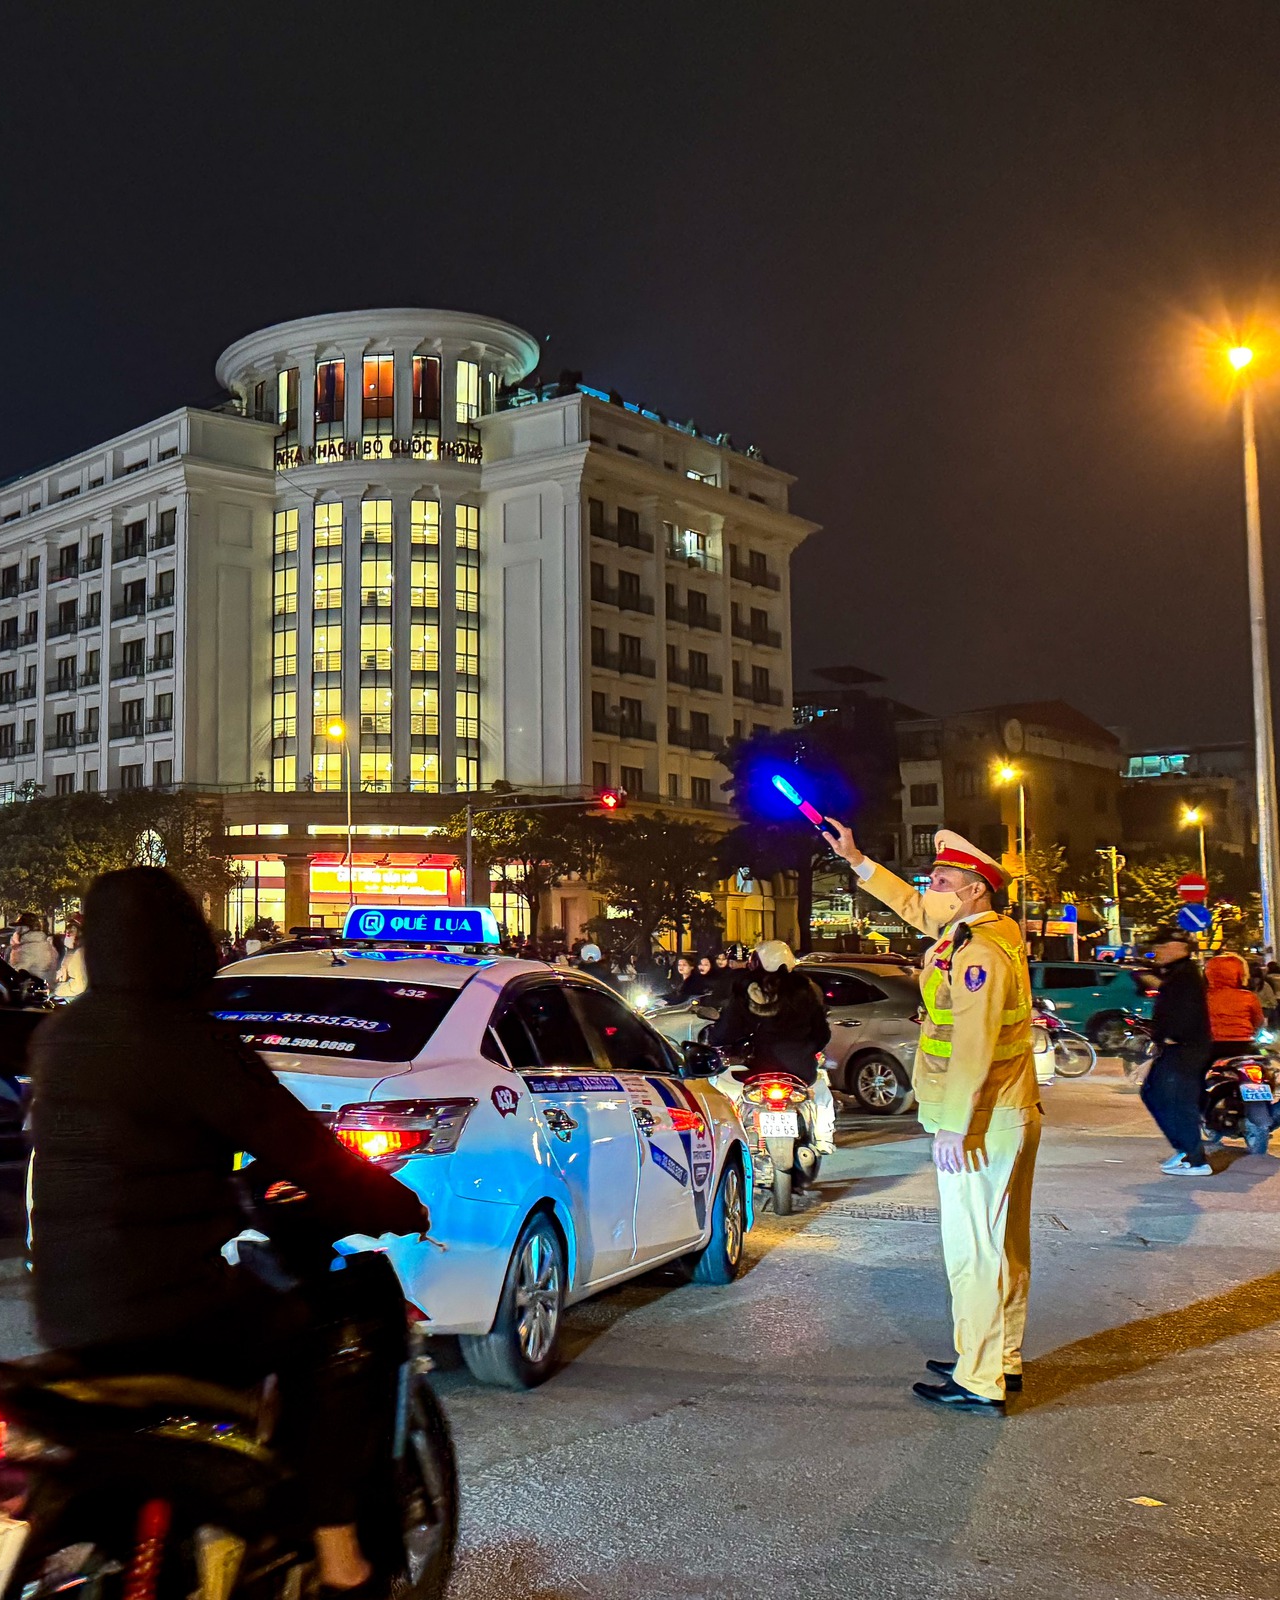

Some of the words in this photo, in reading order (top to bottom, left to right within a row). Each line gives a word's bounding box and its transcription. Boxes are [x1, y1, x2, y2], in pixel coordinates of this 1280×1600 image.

[363, 435, 383, 459] BỘ
[390, 914, 427, 932] QUÊ
[434, 918, 472, 935] LỤA
[394, 987, 428, 999] 432
[276, 1013, 380, 1031] 33.533.533
[495, 1089, 517, 1110] 432
